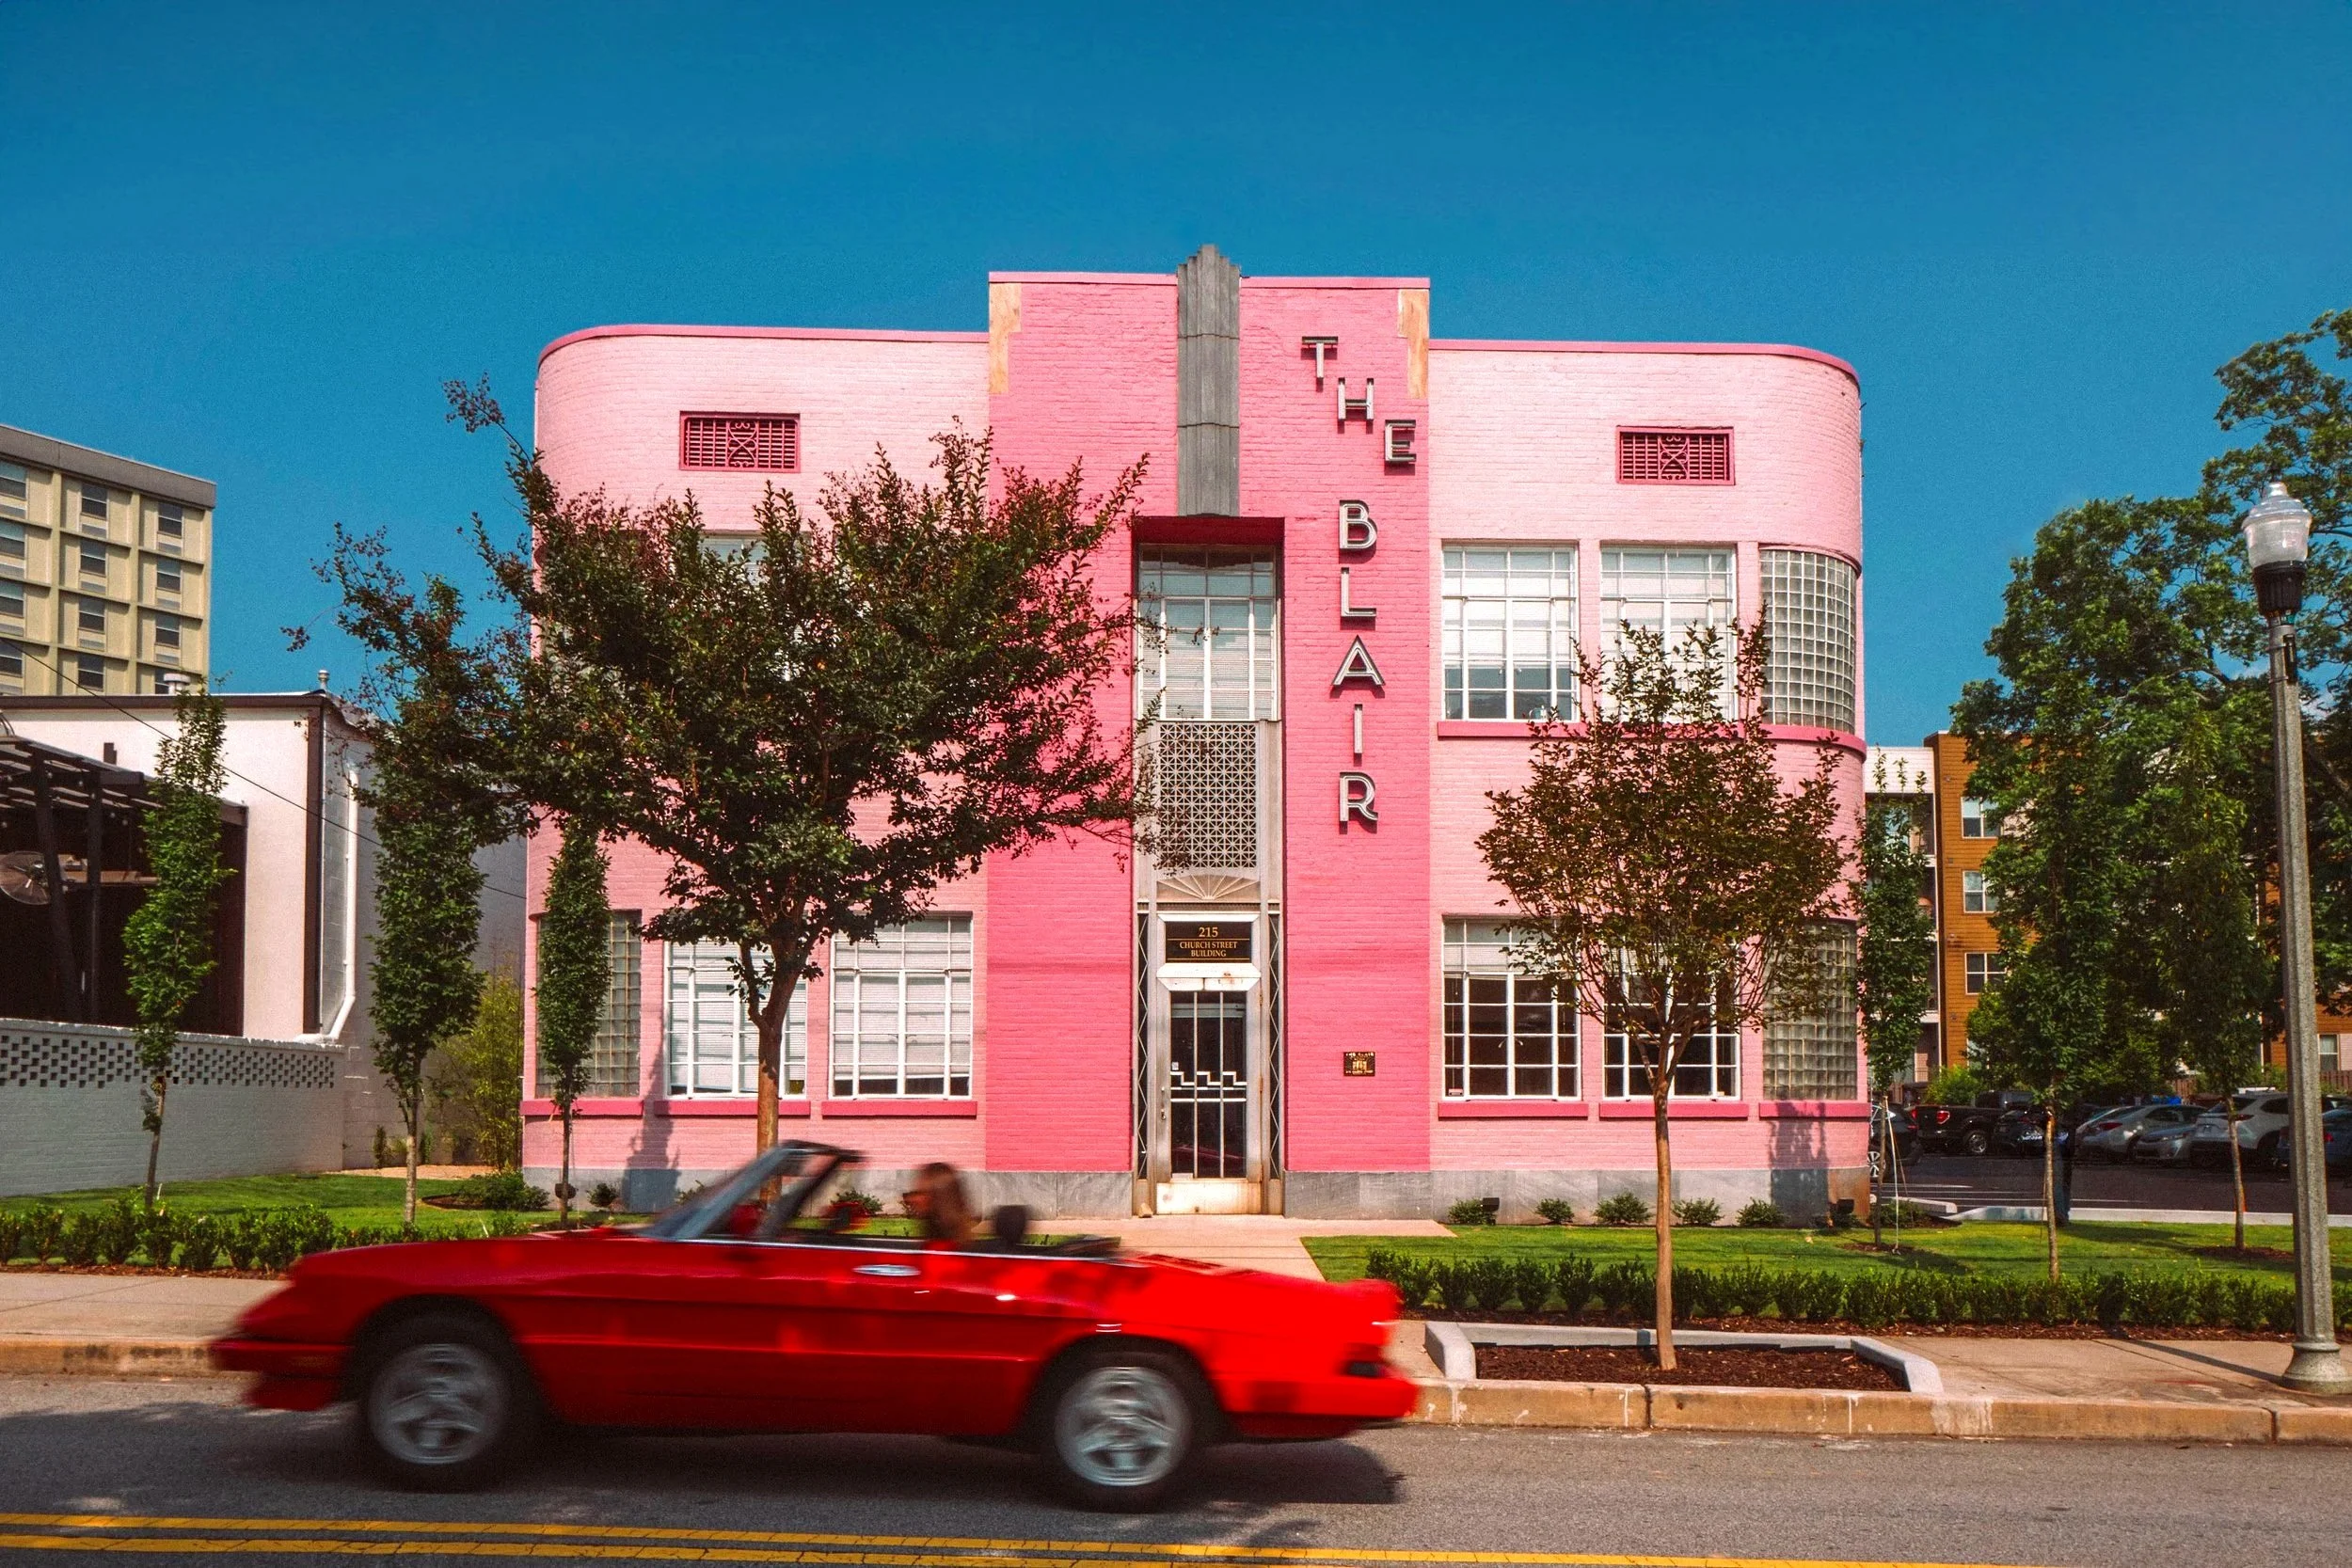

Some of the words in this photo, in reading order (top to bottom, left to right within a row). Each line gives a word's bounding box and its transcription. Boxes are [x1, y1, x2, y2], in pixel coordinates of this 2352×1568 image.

[1302, 336, 1416, 462] THE
[1331, 499, 1386, 821] BLAIR
[1199, 927, 1218, 937] 215
